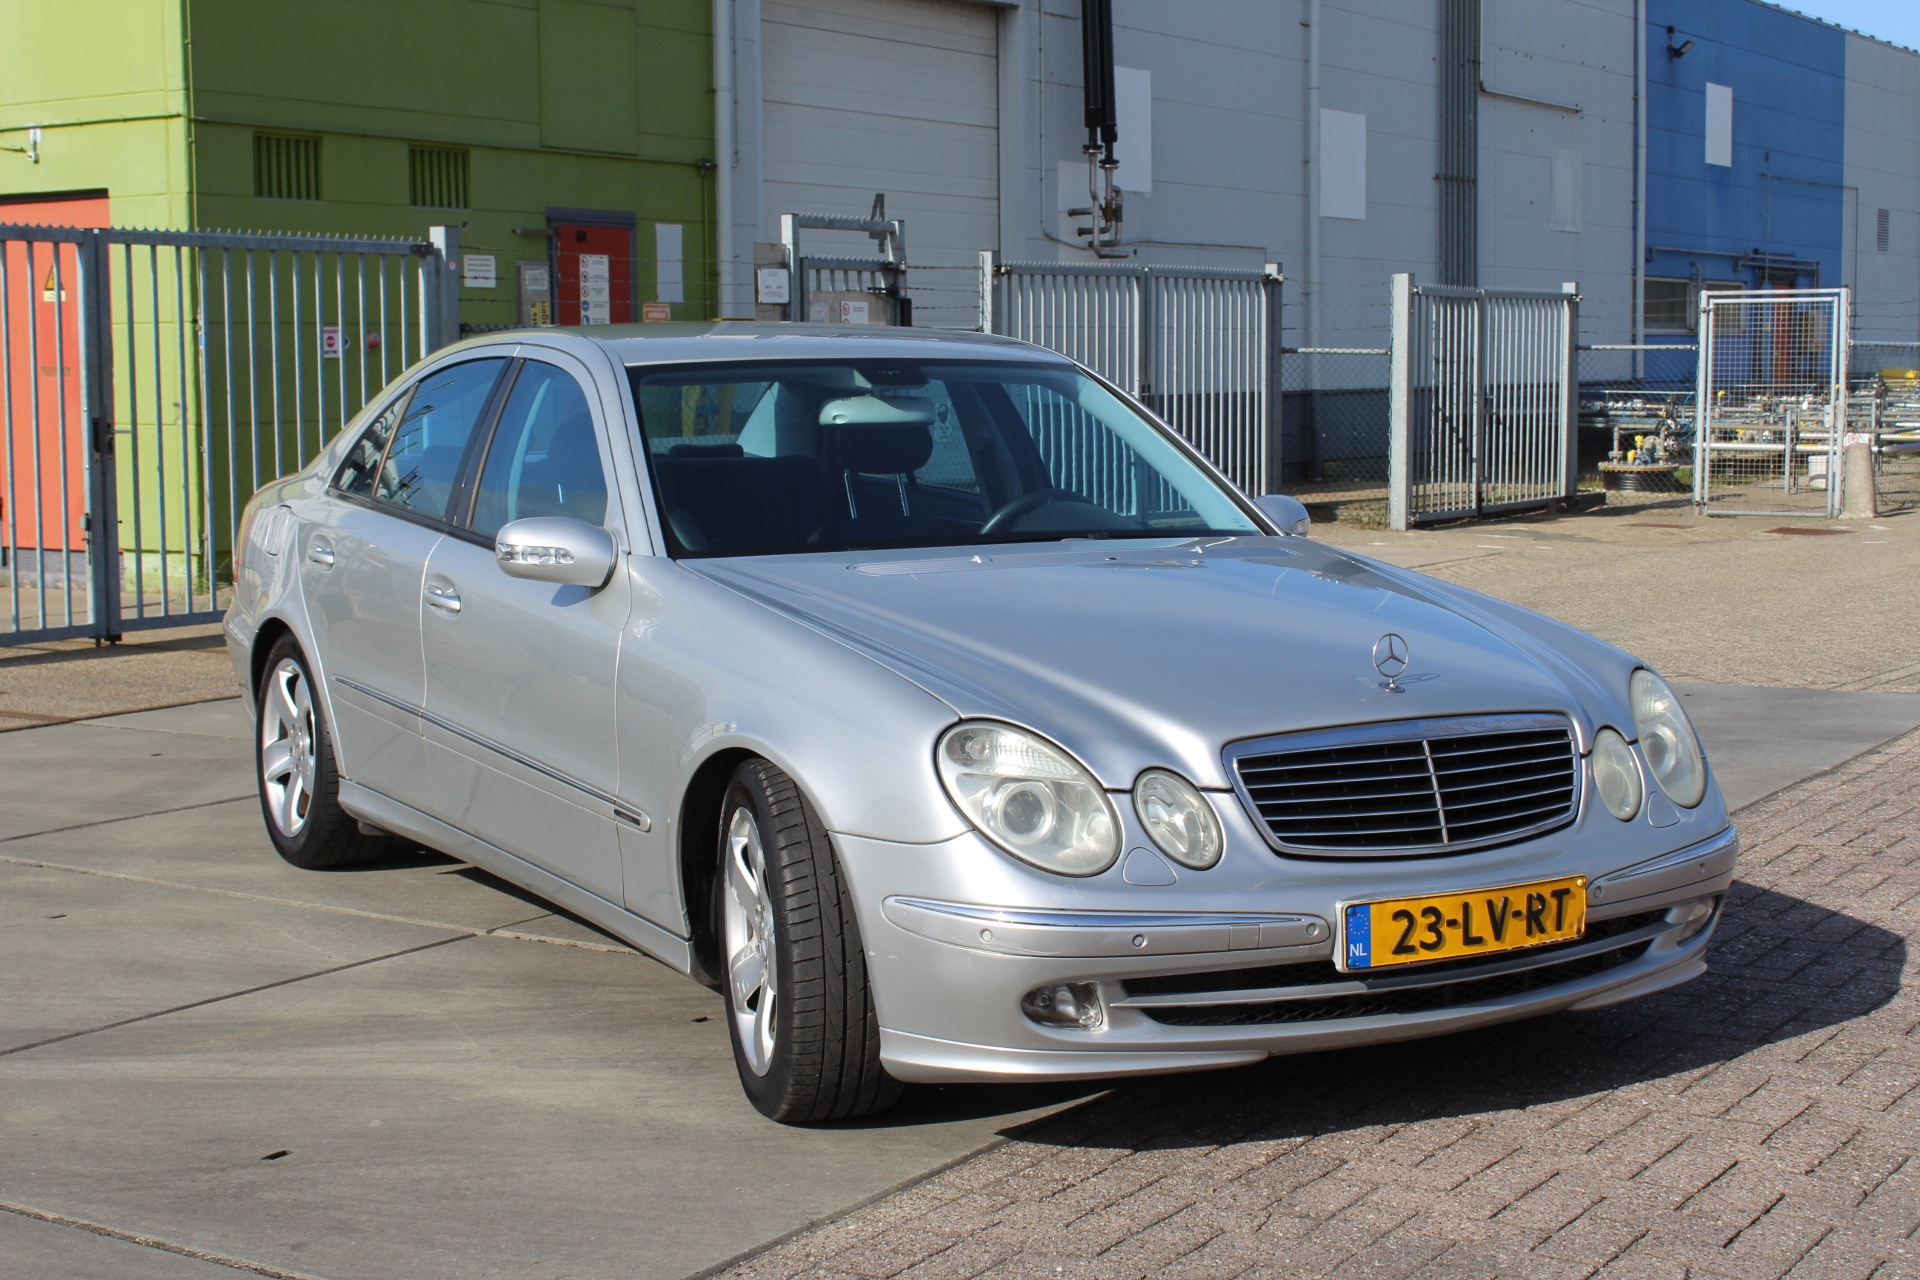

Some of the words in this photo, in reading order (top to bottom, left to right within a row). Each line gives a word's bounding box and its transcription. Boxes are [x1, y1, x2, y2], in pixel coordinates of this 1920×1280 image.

[868, 193, 888, 253] 4
[1349, 943, 1368, 957] NL
[1391, 887, 1571, 955] 23-LV-RT
